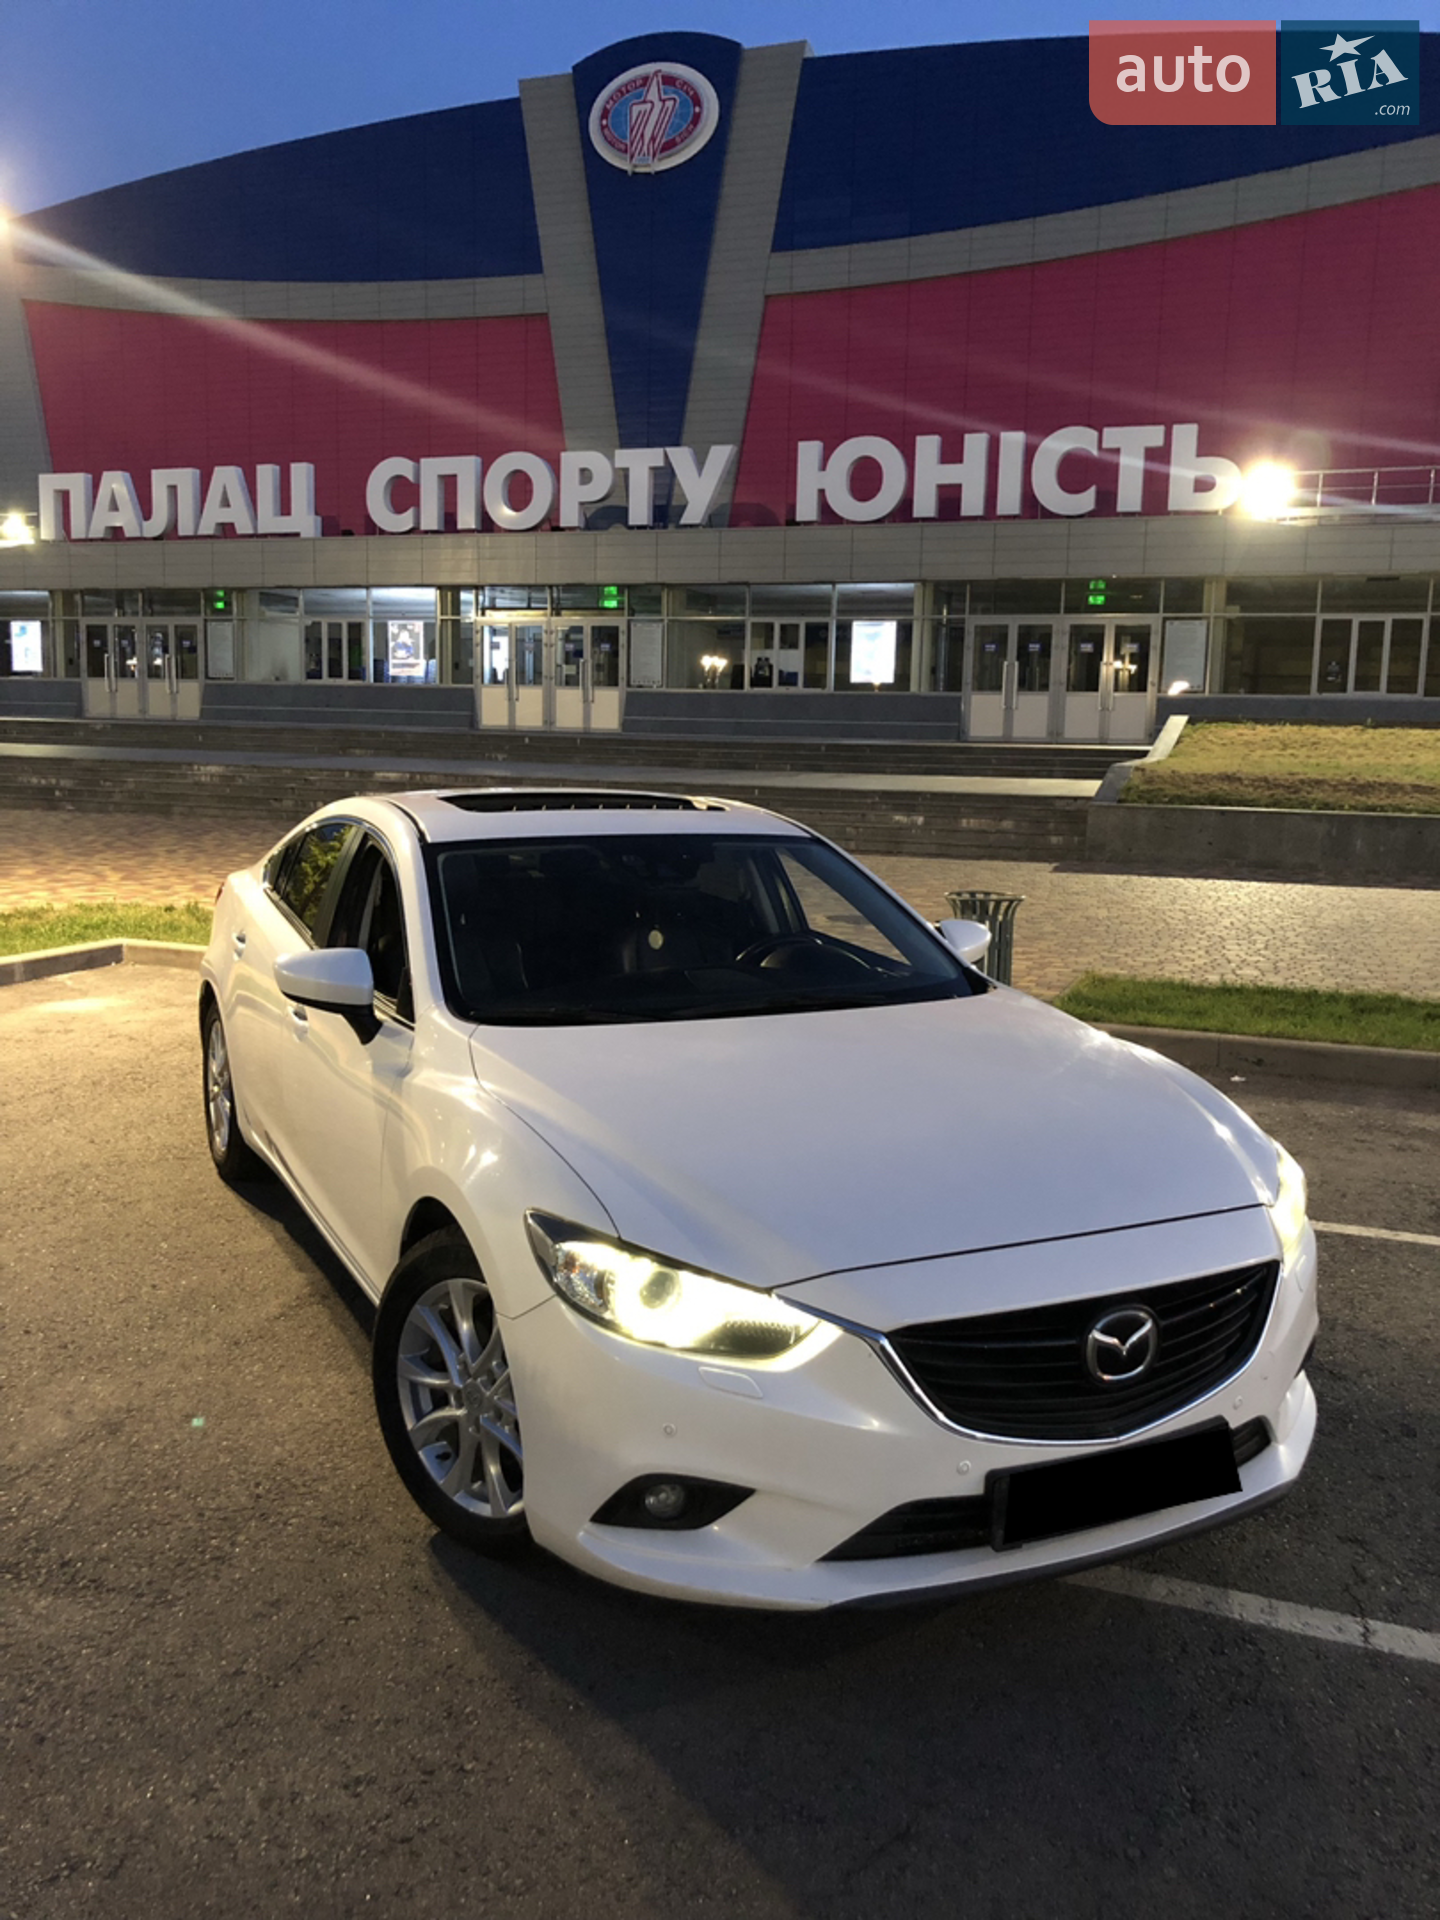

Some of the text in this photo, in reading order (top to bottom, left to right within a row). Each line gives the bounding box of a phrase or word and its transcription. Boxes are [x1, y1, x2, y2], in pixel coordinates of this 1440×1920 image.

[38, 423, 1243, 540] ПАЛАЦ СПОРТУ ЮНІСТЬ
